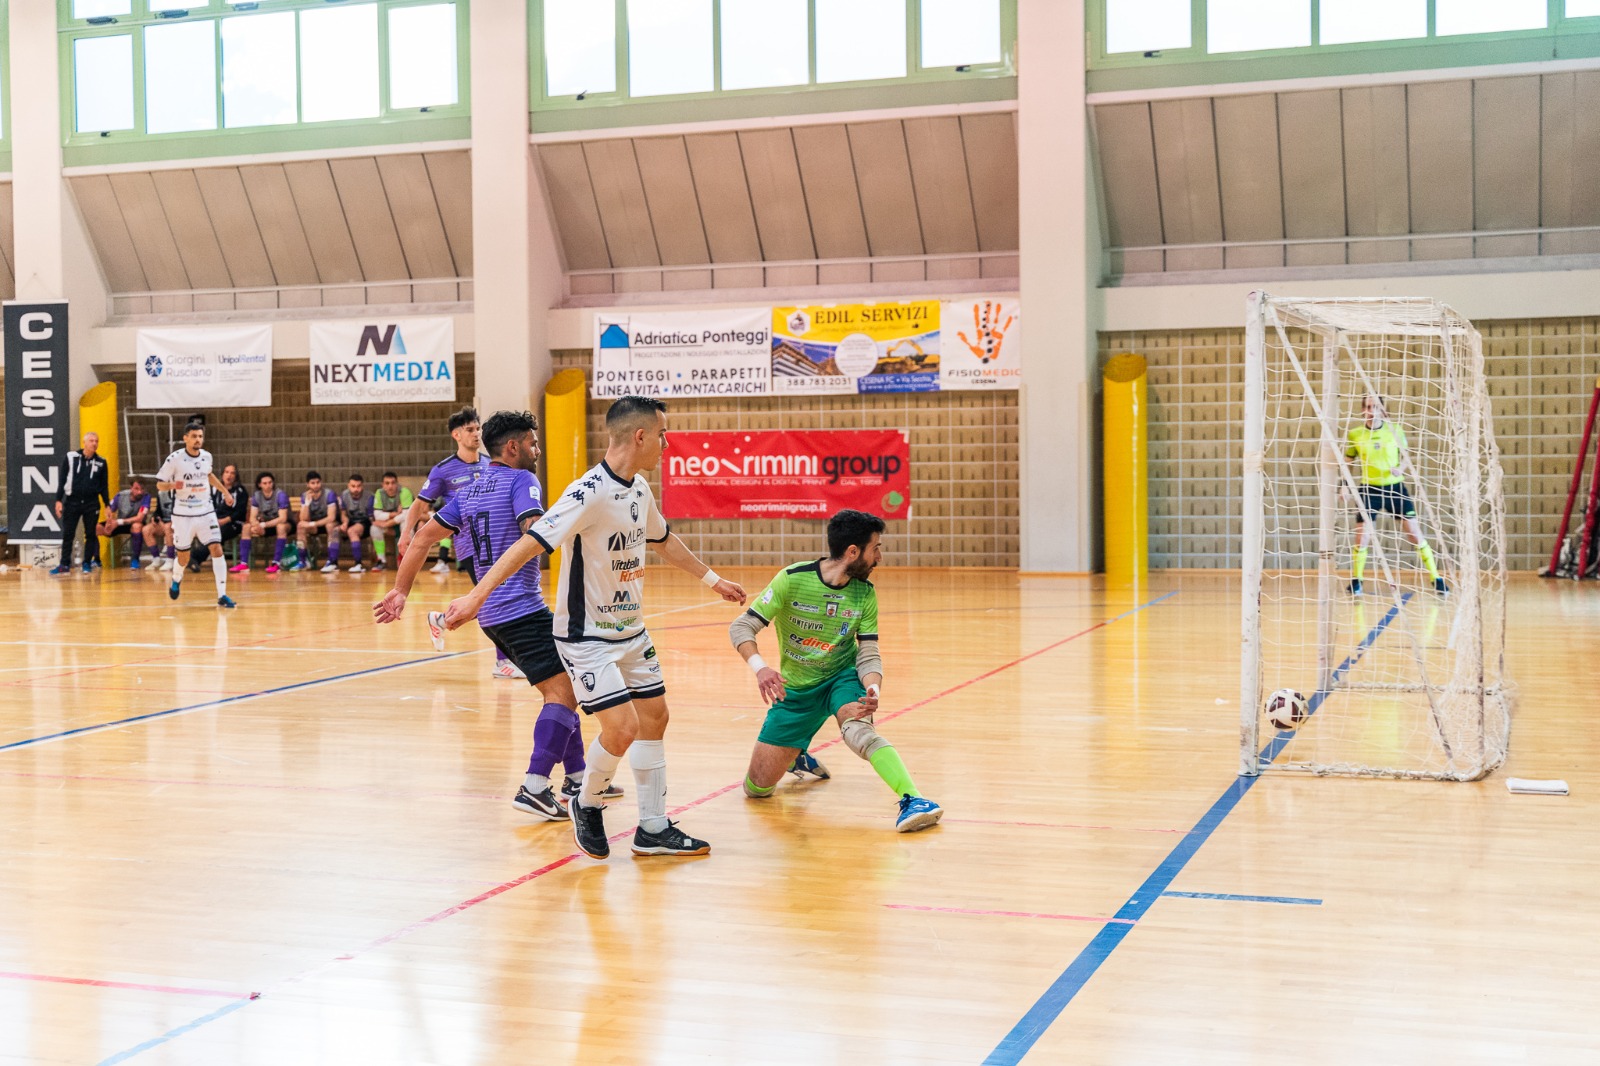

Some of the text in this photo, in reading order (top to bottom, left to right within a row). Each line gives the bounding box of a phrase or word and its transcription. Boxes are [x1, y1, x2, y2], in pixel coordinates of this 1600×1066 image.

[815, 306, 928, 324] EDIL SERVIZI
[634, 327, 768, 345] Adriatica Ponteggi
[166, 353, 206, 366] Giorgini
[165, 367, 212, 378] Rusciano
[314, 360, 451, 383] NEXTMEDIA
[596, 367, 767, 382] PONTEGGI PARAPETTI
[314, 383, 452, 398] Sistemi di Comunicazione
[596, 381, 767, 396] LINEA VITA MONTACARICHI
[19, 311, 61, 532] CESENA
[822, 454, 901, 484] group
[741, 501, 827, 514] neonriminigroup.it
